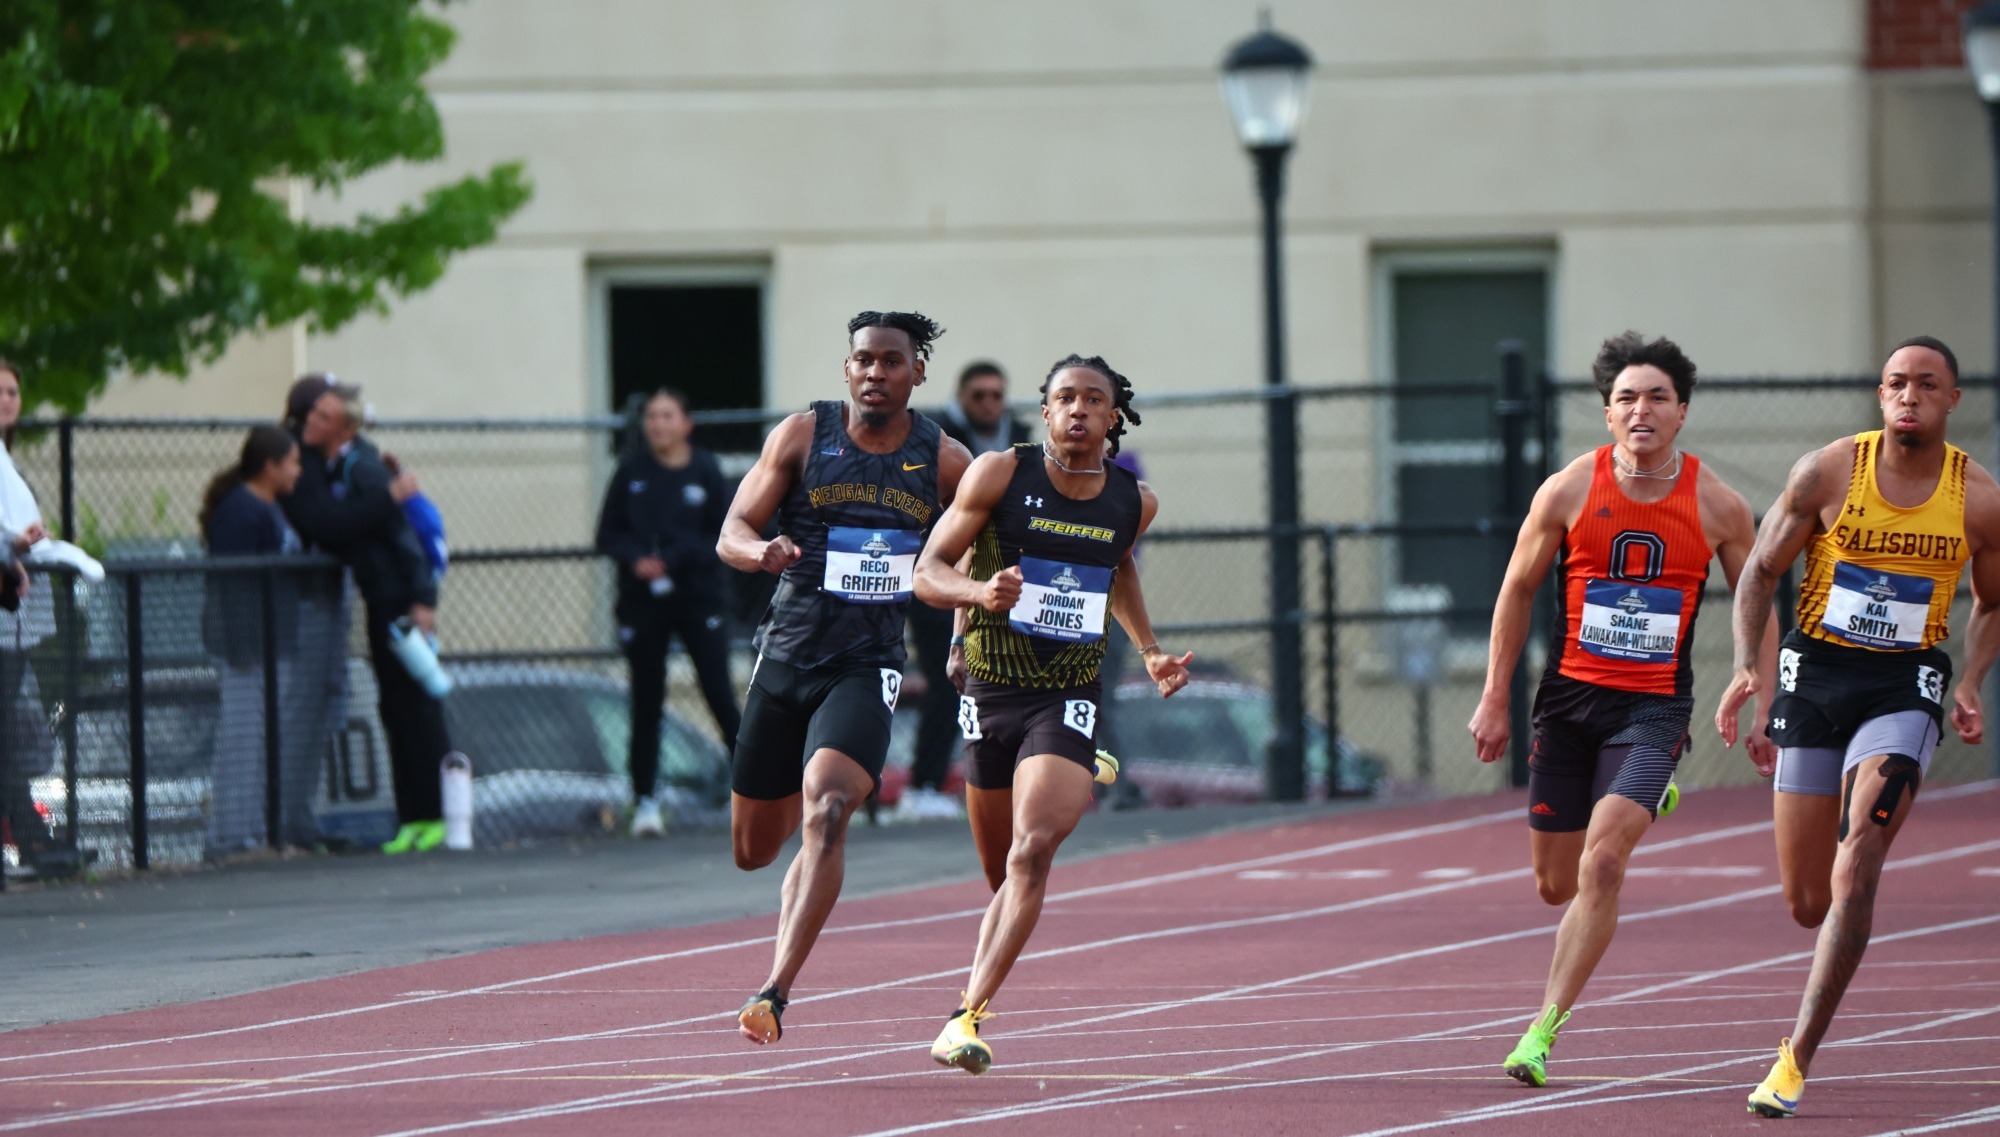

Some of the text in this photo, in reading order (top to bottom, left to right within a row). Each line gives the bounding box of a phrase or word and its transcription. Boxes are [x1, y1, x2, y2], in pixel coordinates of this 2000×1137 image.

[808, 483, 932, 524] MEDGAR EVERS
[1028, 516, 1116, 543] PFEIFFER
[1835, 525, 1962, 561] SALISBURY
[860, 560, 890, 573] RECO
[1609, 529, 1666, 583] O
[841, 574, 900, 592] GRIFFITH
[1038, 593, 1086, 610] JORDAN
[1865, 602, 1888, 618] KAI
[1034, 609, 1084, 630] JONES
[1610, 614, 1650, 631] SHANE
[1847, 615, 1899, 639] SMITH
[1581, 624, 1676, 652] KAWAKAMI-WILLIAMS
[886, 673, 899, 708] 9
[1073, 702, 1090, 729] 8
